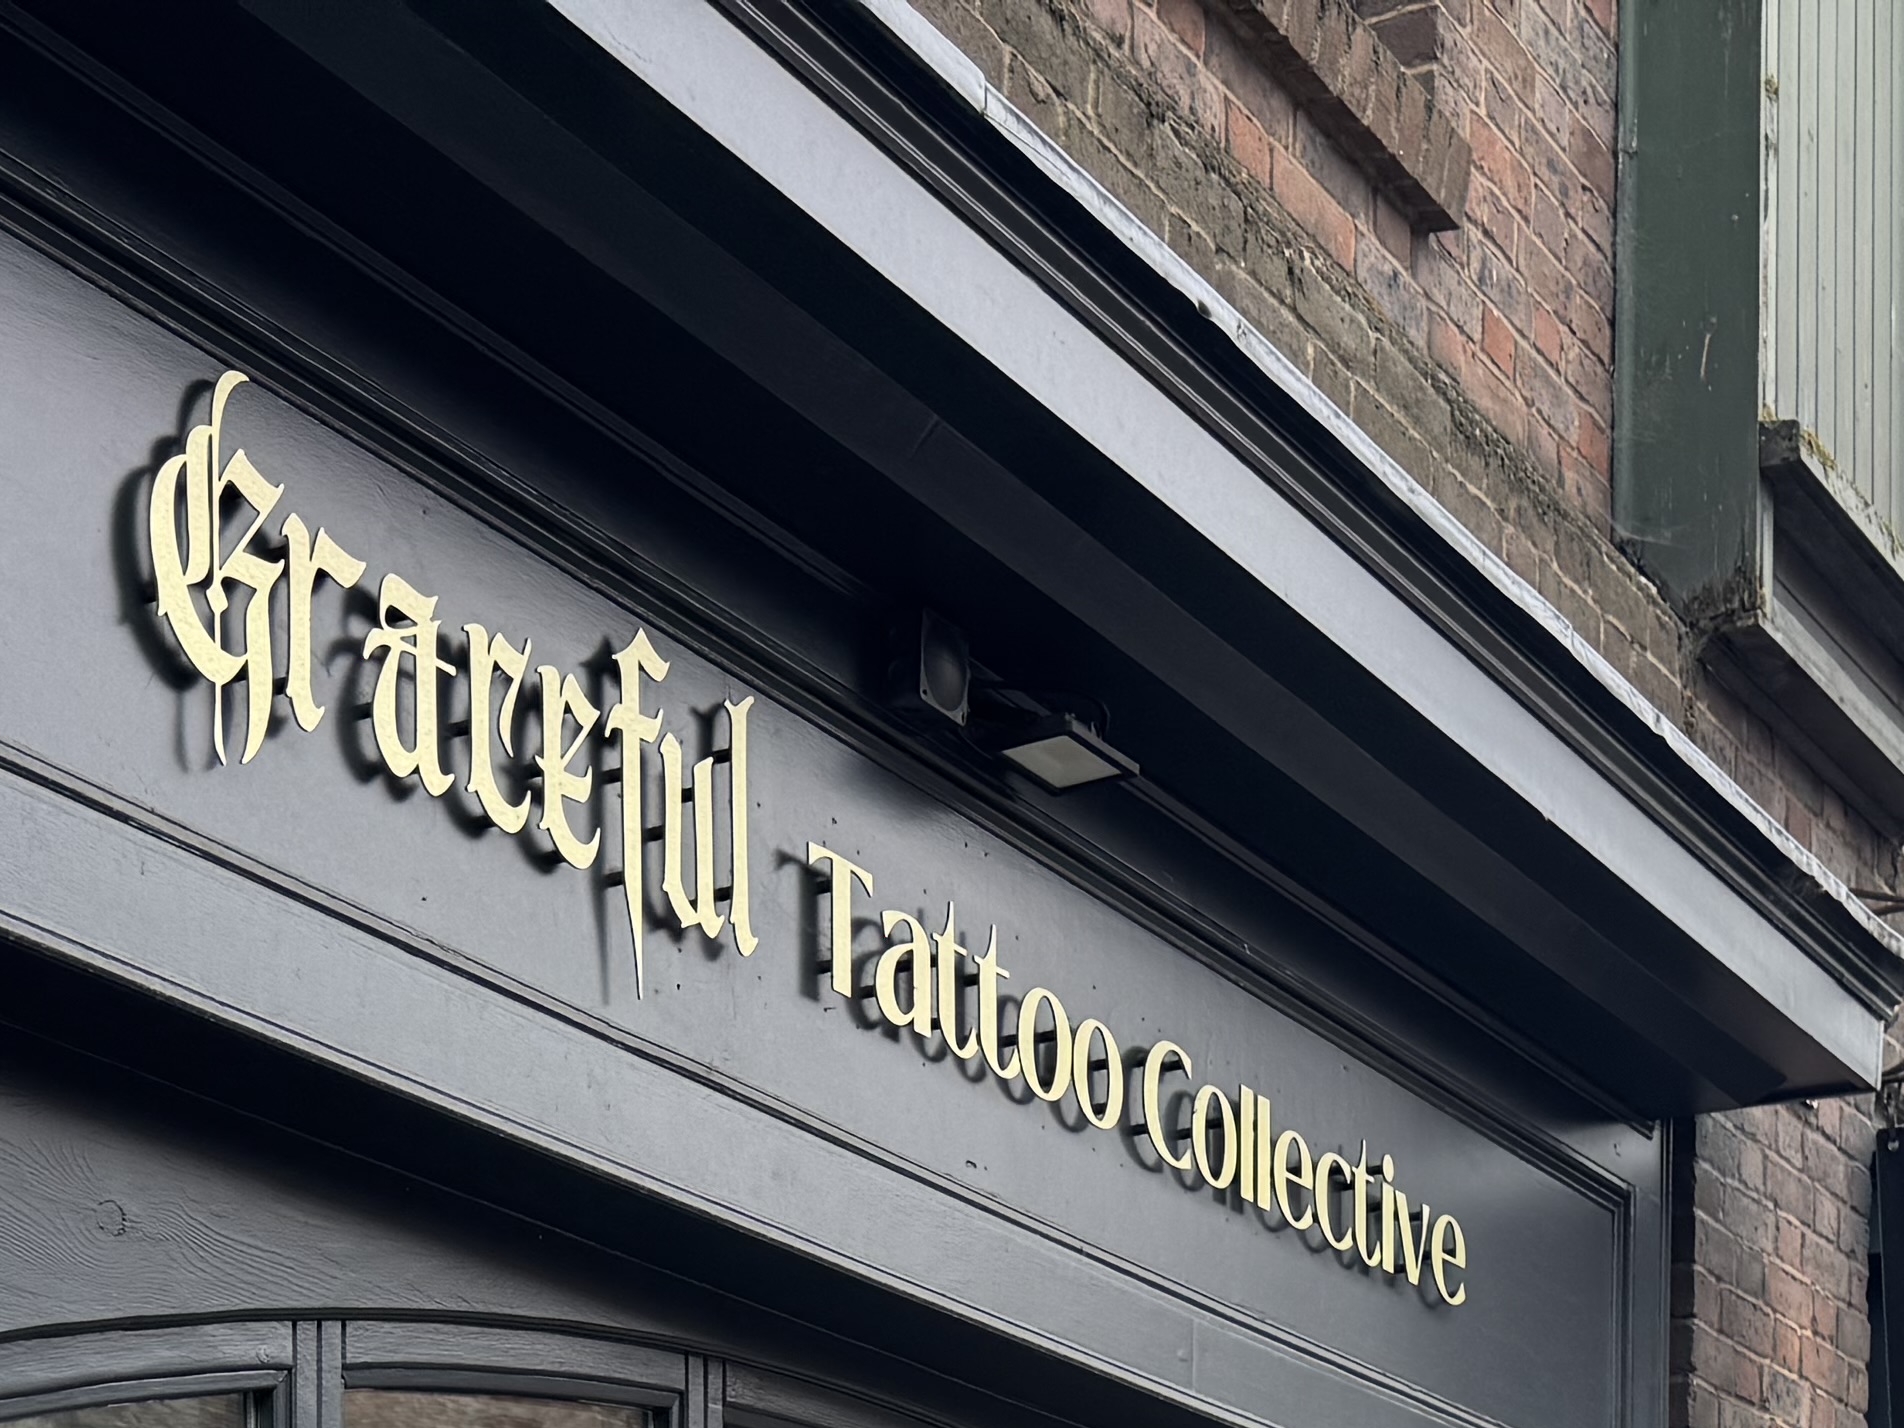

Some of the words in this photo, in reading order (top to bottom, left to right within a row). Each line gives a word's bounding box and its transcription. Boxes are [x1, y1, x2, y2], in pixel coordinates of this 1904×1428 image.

[149, 370, 759, 1000] Graceful
[807, 841, 1123, 1130] Tattoo
[1143, 1040, 1466, 1305] Collective
